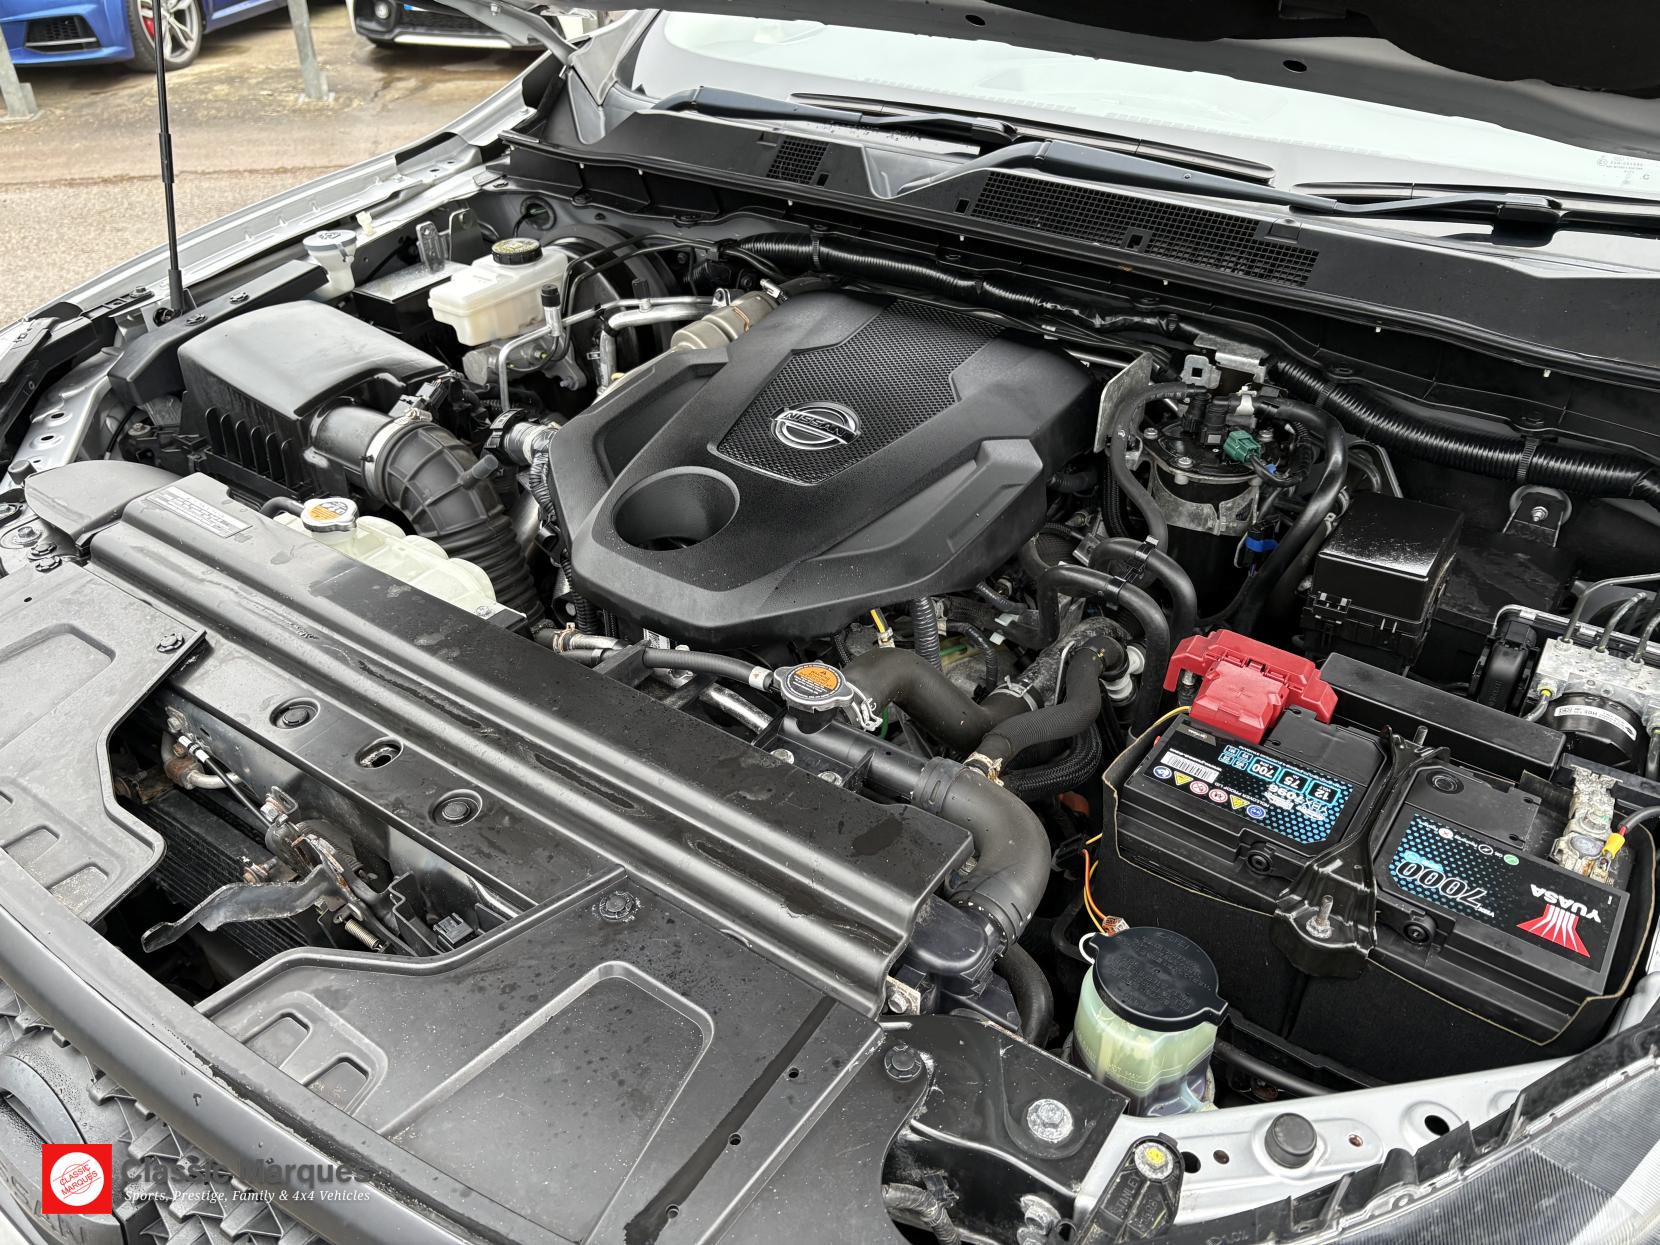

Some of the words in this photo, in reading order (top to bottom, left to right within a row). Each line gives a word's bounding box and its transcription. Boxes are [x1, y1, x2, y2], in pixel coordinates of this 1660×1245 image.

[784, 411, 846, 437] NISSAN
[1252, 764, 1275, 777] 700
[1284, 776, 1301, 789] 75
[1268, 783, 1328, 814] YBX7096
[1314, 789, 1330, 801] 12
[1396, 860, 1488, 908] 7000
[1530, 883, 1602, 923] YUASA
[1112, 1174, 1142, 1217] STANLEY
